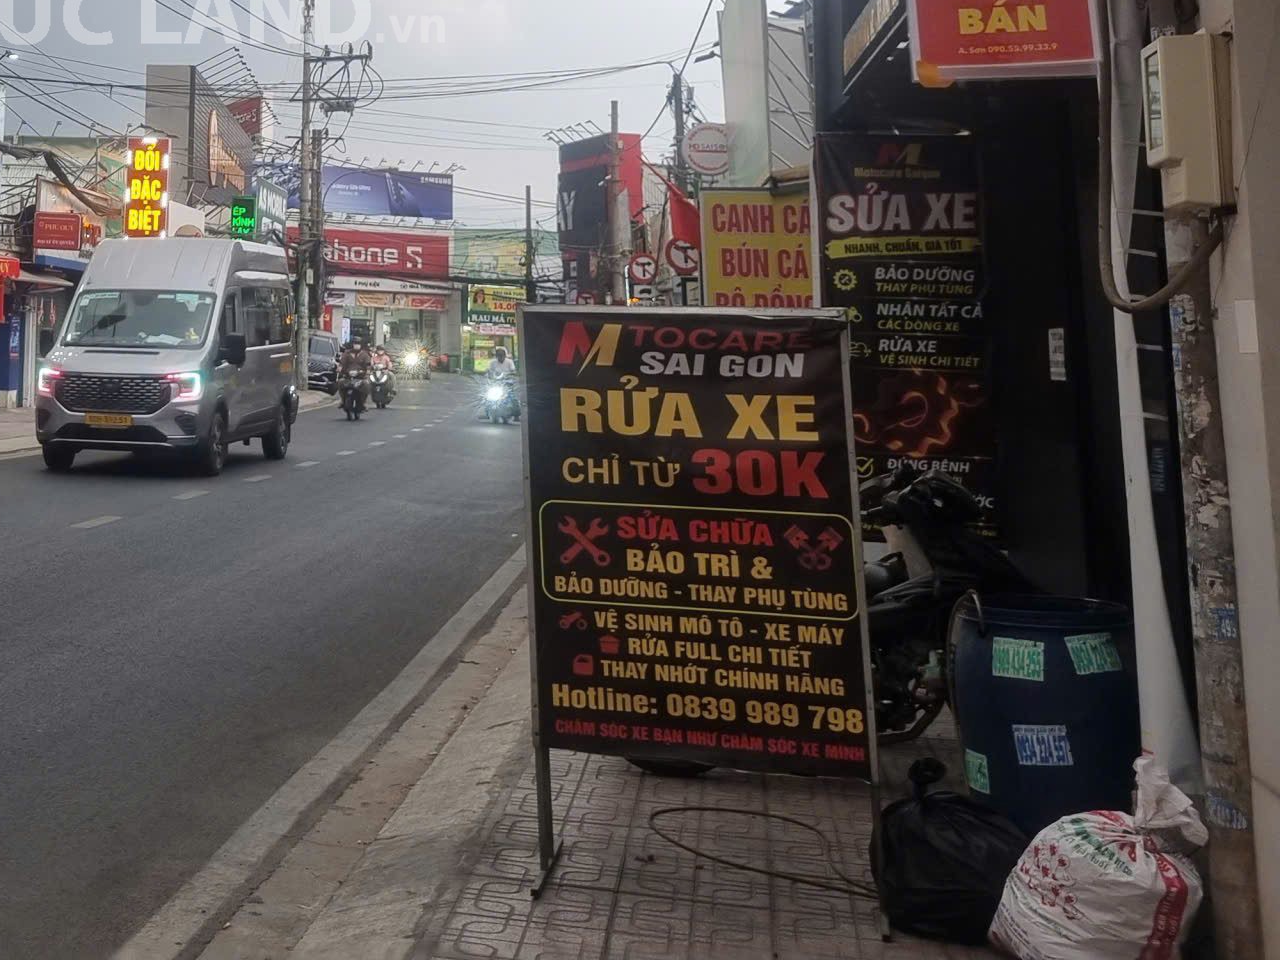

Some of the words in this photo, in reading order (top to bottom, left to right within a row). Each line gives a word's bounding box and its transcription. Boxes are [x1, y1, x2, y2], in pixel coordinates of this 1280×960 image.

[957, 0, 1048, 36] BÁN
[128, 205, 162, 236] BIỆT
[711, 202, 776, 234] CANH
[783, 198, 812, 235] CÁ
[826, 182, 911, 232] SỬA
[922, 192, 976, 230] XE
[721, 241, 769, 278] BÚN
[777, 240, 810, 278] CÁ
[844, 242, 883, 255] NHANH,
[875, 263, 910, 282] BẢO
[912, 267, 976, 283] DƯỠNG
[876, 281, 908, 294] THAY
[910, 283, 936, 296] PHỤ
[939, 282, 974, 296] TÙNG
[471, 313, 490, 322] RAU
[877, 301, 925, 320] NHẬN
[928, 301, 957, 317] TẤT
[961, 301, 983, 318] CẢ
[878, 318, 903, 331] CÁC
[905, 318, 942, 332] DÒNG
[945, 321, 960, 332] XE
[878, 335, 916, 353] RỬA
[917, 340, 937, 354] XE
[879, 354, 896, 367] VỆ
[897, 355, 928, 367] SINH
[930, 356, 952, 367] CHI
[953, 355, 981, 368] TIẾT
[639, 350, 705, 377] SAI
[719, 353, 806, 379] GON
[559, 375, 704, 440] RỬA
[725, 393, 821, 442] XE
[562, 451, 622, 486] CHỈ
[629, 455, 682, 489] TỪ
[690, 447, 830, 500] 30K
[616, 508, 680, 541] SỬA
[688, 518, 774, 548] CHỮA
[626, 542, 686, 575] BẢO
[693, 547, 741, 578] TRÌ
[750, 555, 774, 580] &
[554, 570, 594, 595] BẢO
[599, 576, 668, 600] DƯỠNG
[687, 584, 739, 606] THAY
[743, 588, 786, 612] PHỤ
[791, 585, 849, 612] TÙNG
[593, 609, 619, 631] VỆ
[624, 613, 673, 634] SINH
[679, 611, 713, 637] MÔ
[717, 615, 745, 639] TÔ
[763, 622, 791, 642] XE
[797, 619, 846, 646] MÁY
[627, 632, 669, 658] RỬA
[674, 640, 722, 662] FULL
[727, 644, 763, 665] CHI
[767, 643, 812, 669] TIẾT
[600, 660, 651, 680] THAY
[654, 662, 709, 686] NHỚT
[714, 666, 780, 691] CHÍNH
[785, 671, 847, 697] HÃNG
[551, 683, 658, 715] Hotline:
[666, 693, 738, 722] 0839
[745, 699, 801, 729] 989
[807, 706, 865, 735] 798
[599, 721, 629, 740] SÓC
[631, 726, 650, 742] XE
[653, 728, 683, 745] BẠN
[686, 730, 718, 748] NHƯ
[767, 734, 798, 756] SÓC
[801, 740, 820, 758] XE
